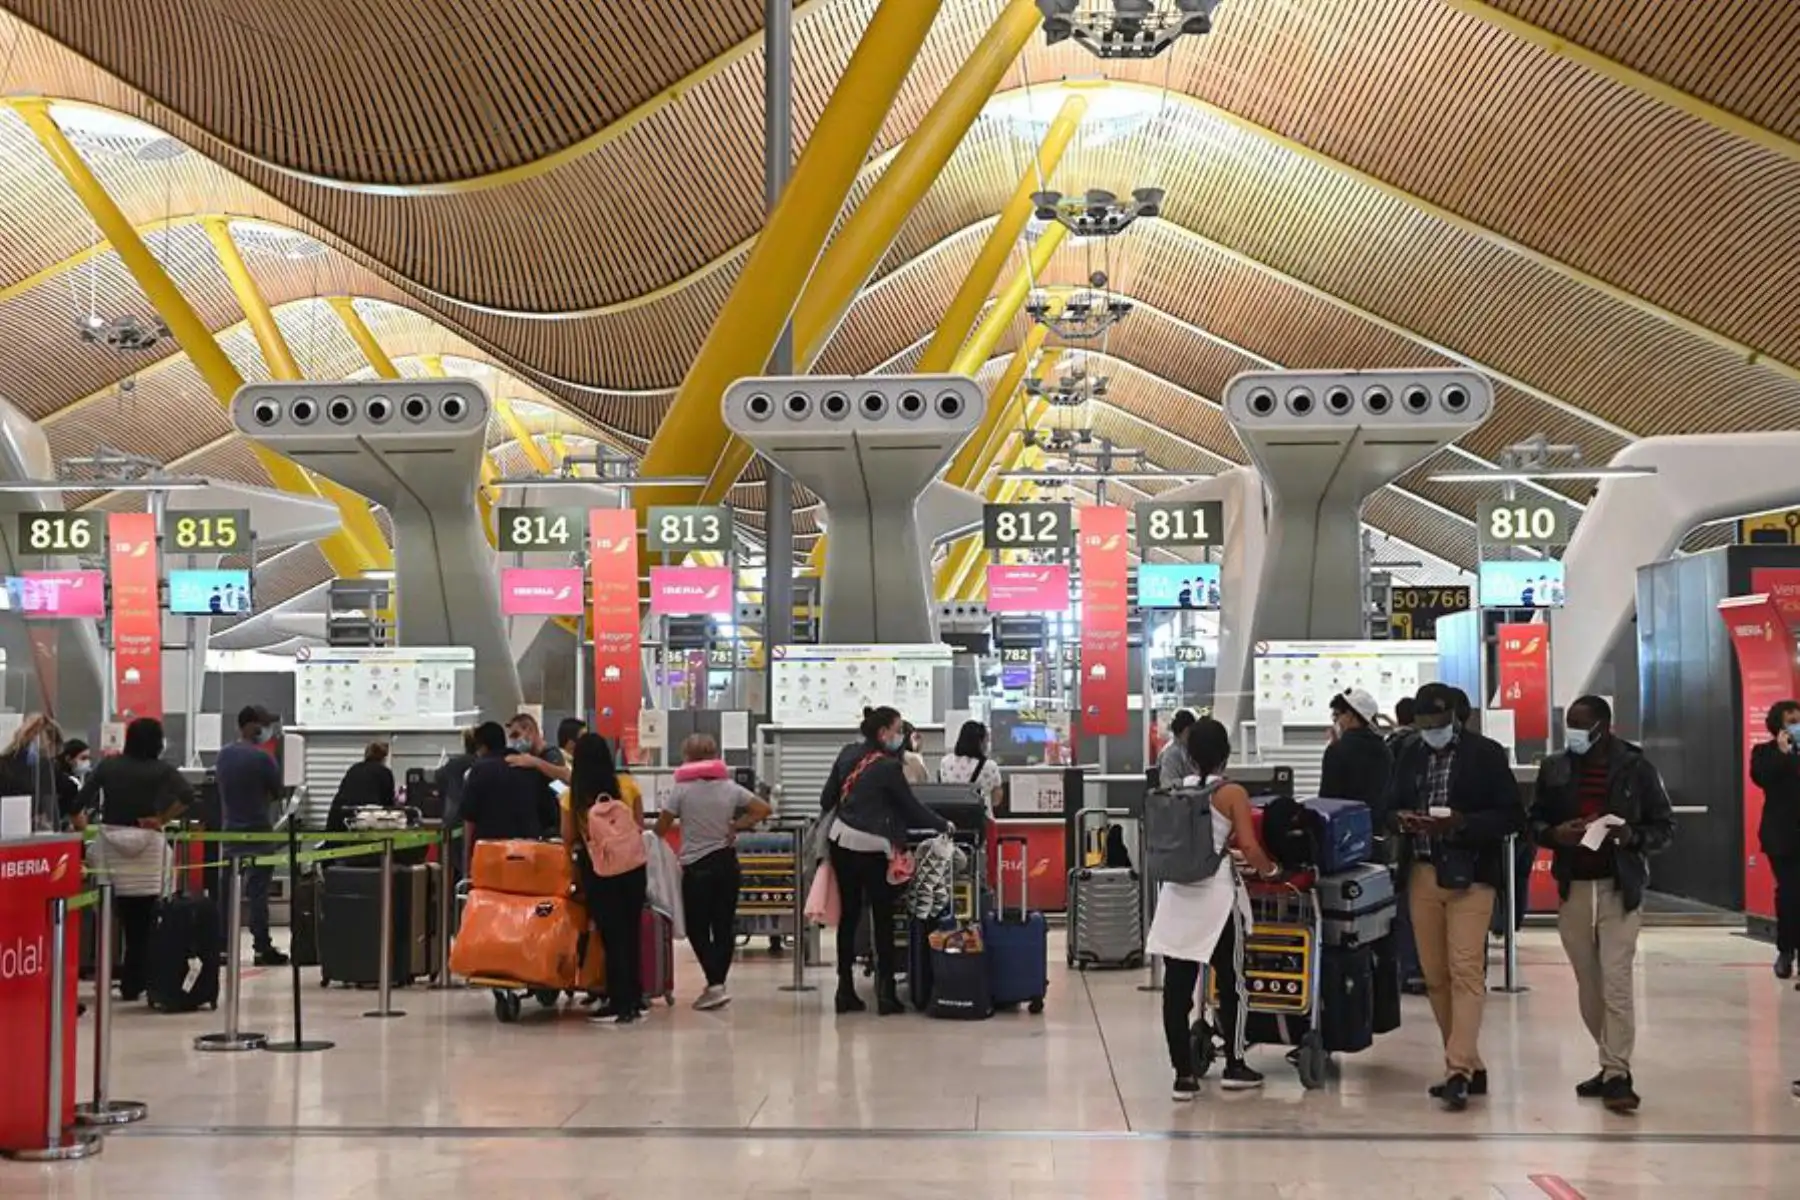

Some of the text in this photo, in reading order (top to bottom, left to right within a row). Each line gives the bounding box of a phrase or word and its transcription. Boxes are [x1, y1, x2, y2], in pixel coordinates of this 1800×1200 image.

[30, 518, 91, 548] 816
[177, 517, 237, 547] 815
[512, 516, 570, 545] 814
[660, 515, 721, 544] 813
[996, 511, 1058, 542] 812
[1149, 508, 1209, 541] 811
[1490, 507, 1555, 538] 810
[513, 586, 555, 596] IBERIA
[662, 586, 705, 595] IBERIA
[1004, 649, 1028, 660] 782
[1, 860, 50, 878] IBERIA
[0, 935, 44, 979] ola!
